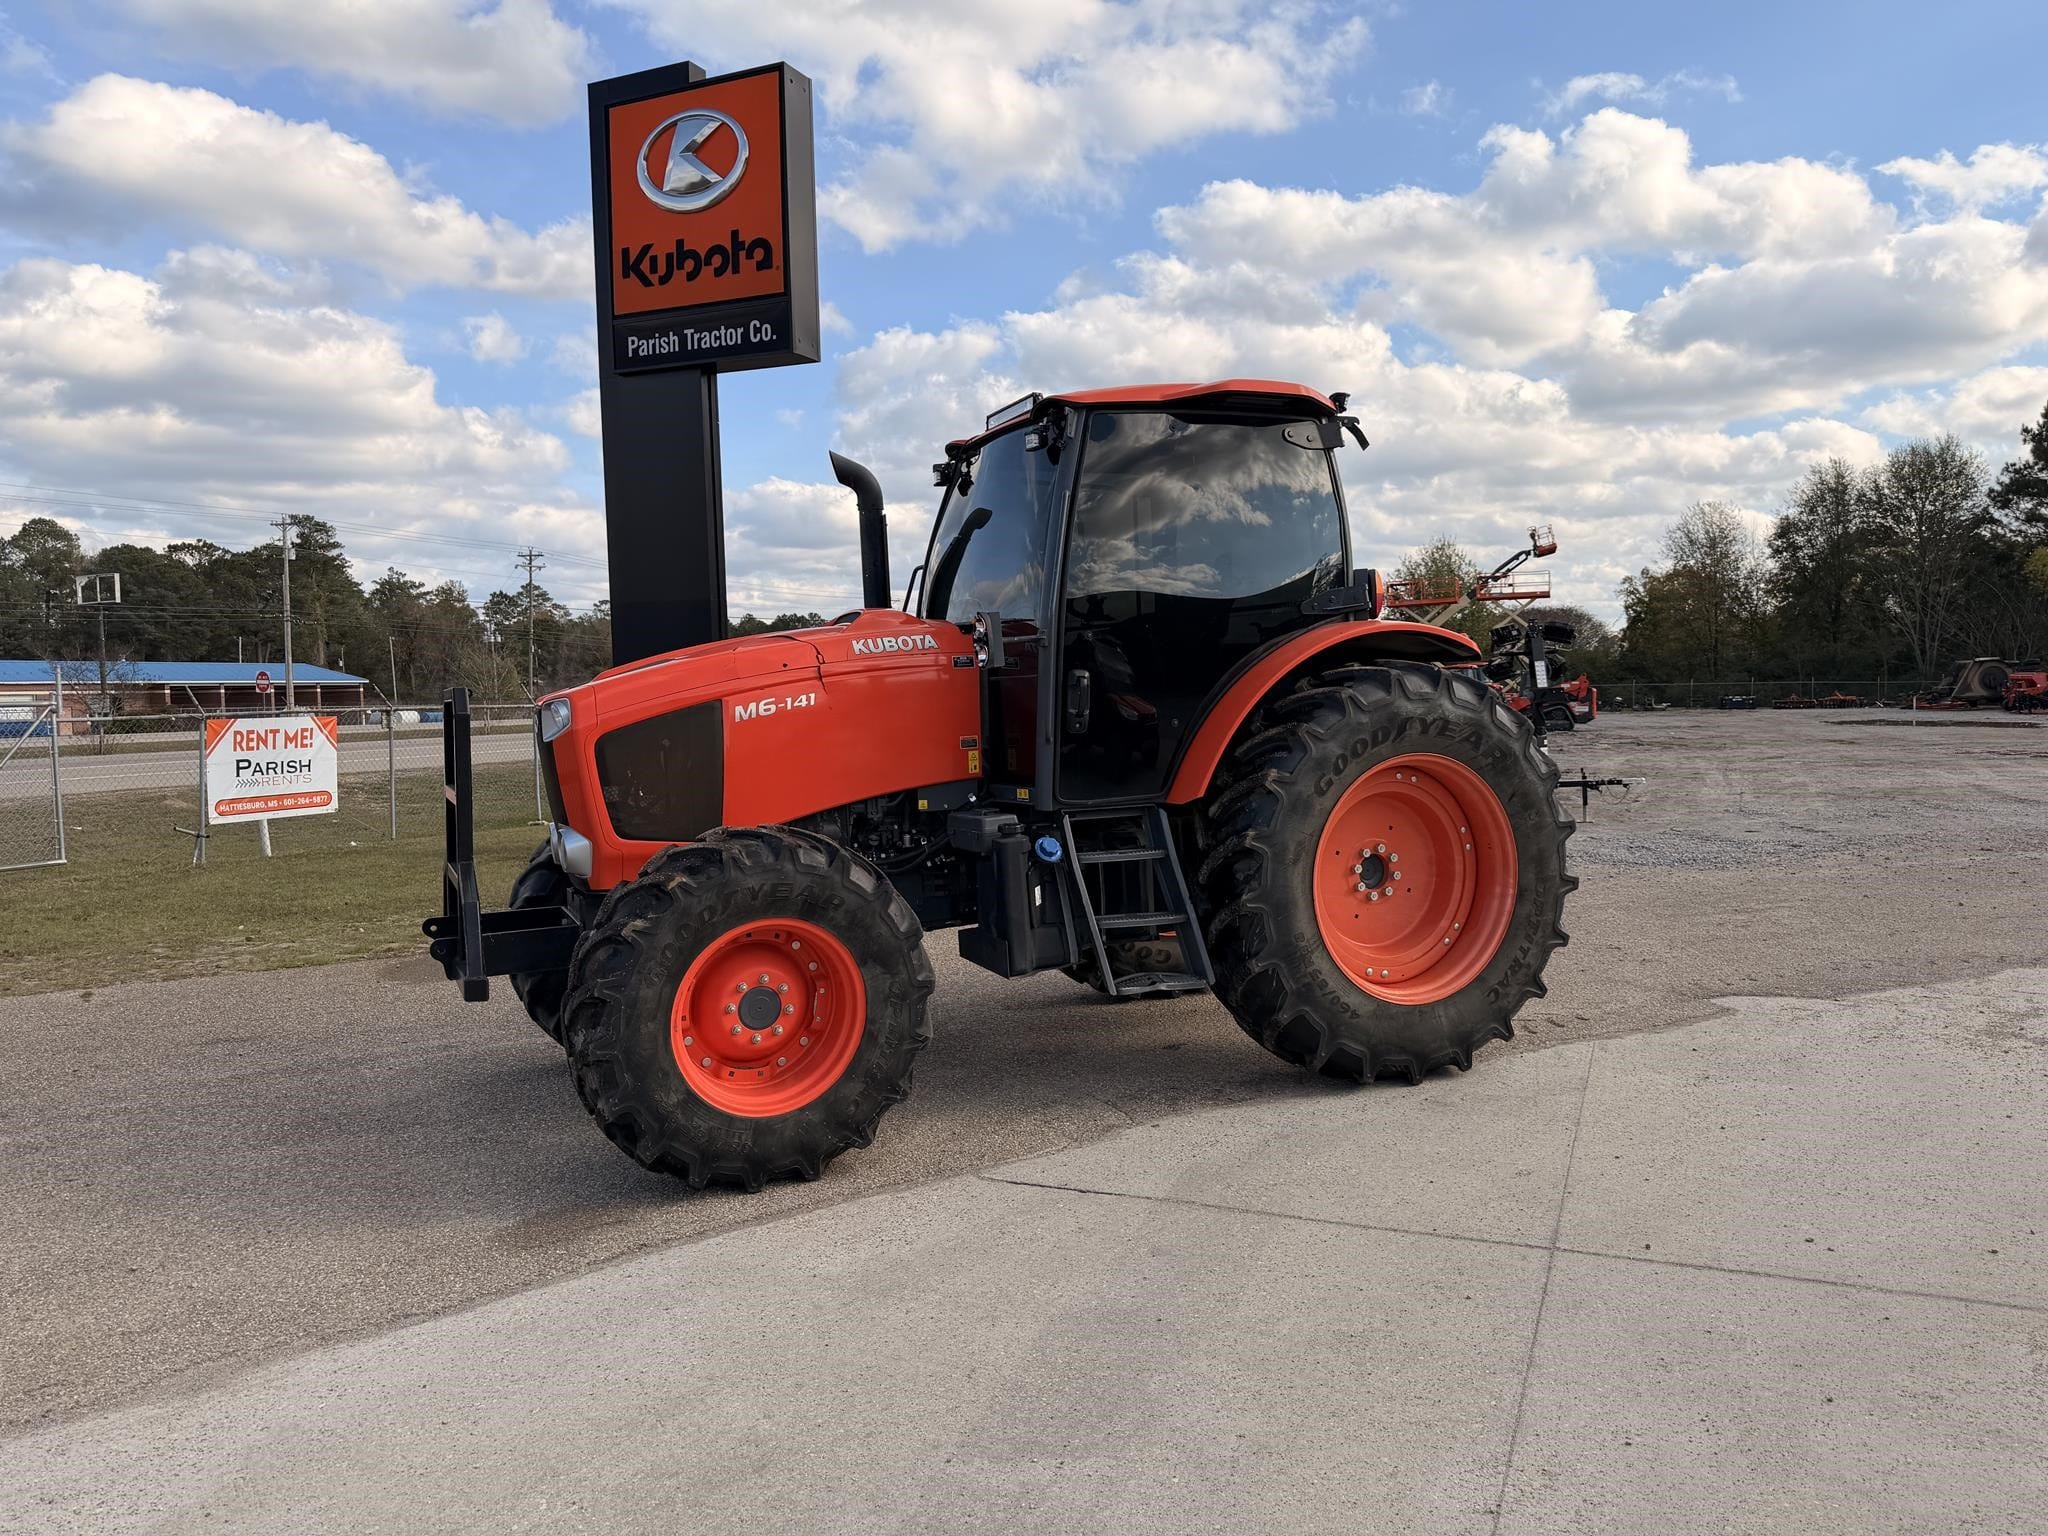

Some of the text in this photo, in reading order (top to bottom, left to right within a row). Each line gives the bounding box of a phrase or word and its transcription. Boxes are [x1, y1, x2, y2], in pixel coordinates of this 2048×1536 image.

[621, 229, 774, 288] Kubota
[627, 319, 777, 358] Parish Tractor Co.
[851, 634, 938, 655] KUBOTA
[734, 692, 816, 722] M6-141
[233, 727, 314, 752] RENT ME!
[235, 759, 312, 777] PARISH
[260, 774, 312, 787] RENTS
[219, 801, 267, 813] HATTIESBURG,
[268, 799, 278, 808] MS
